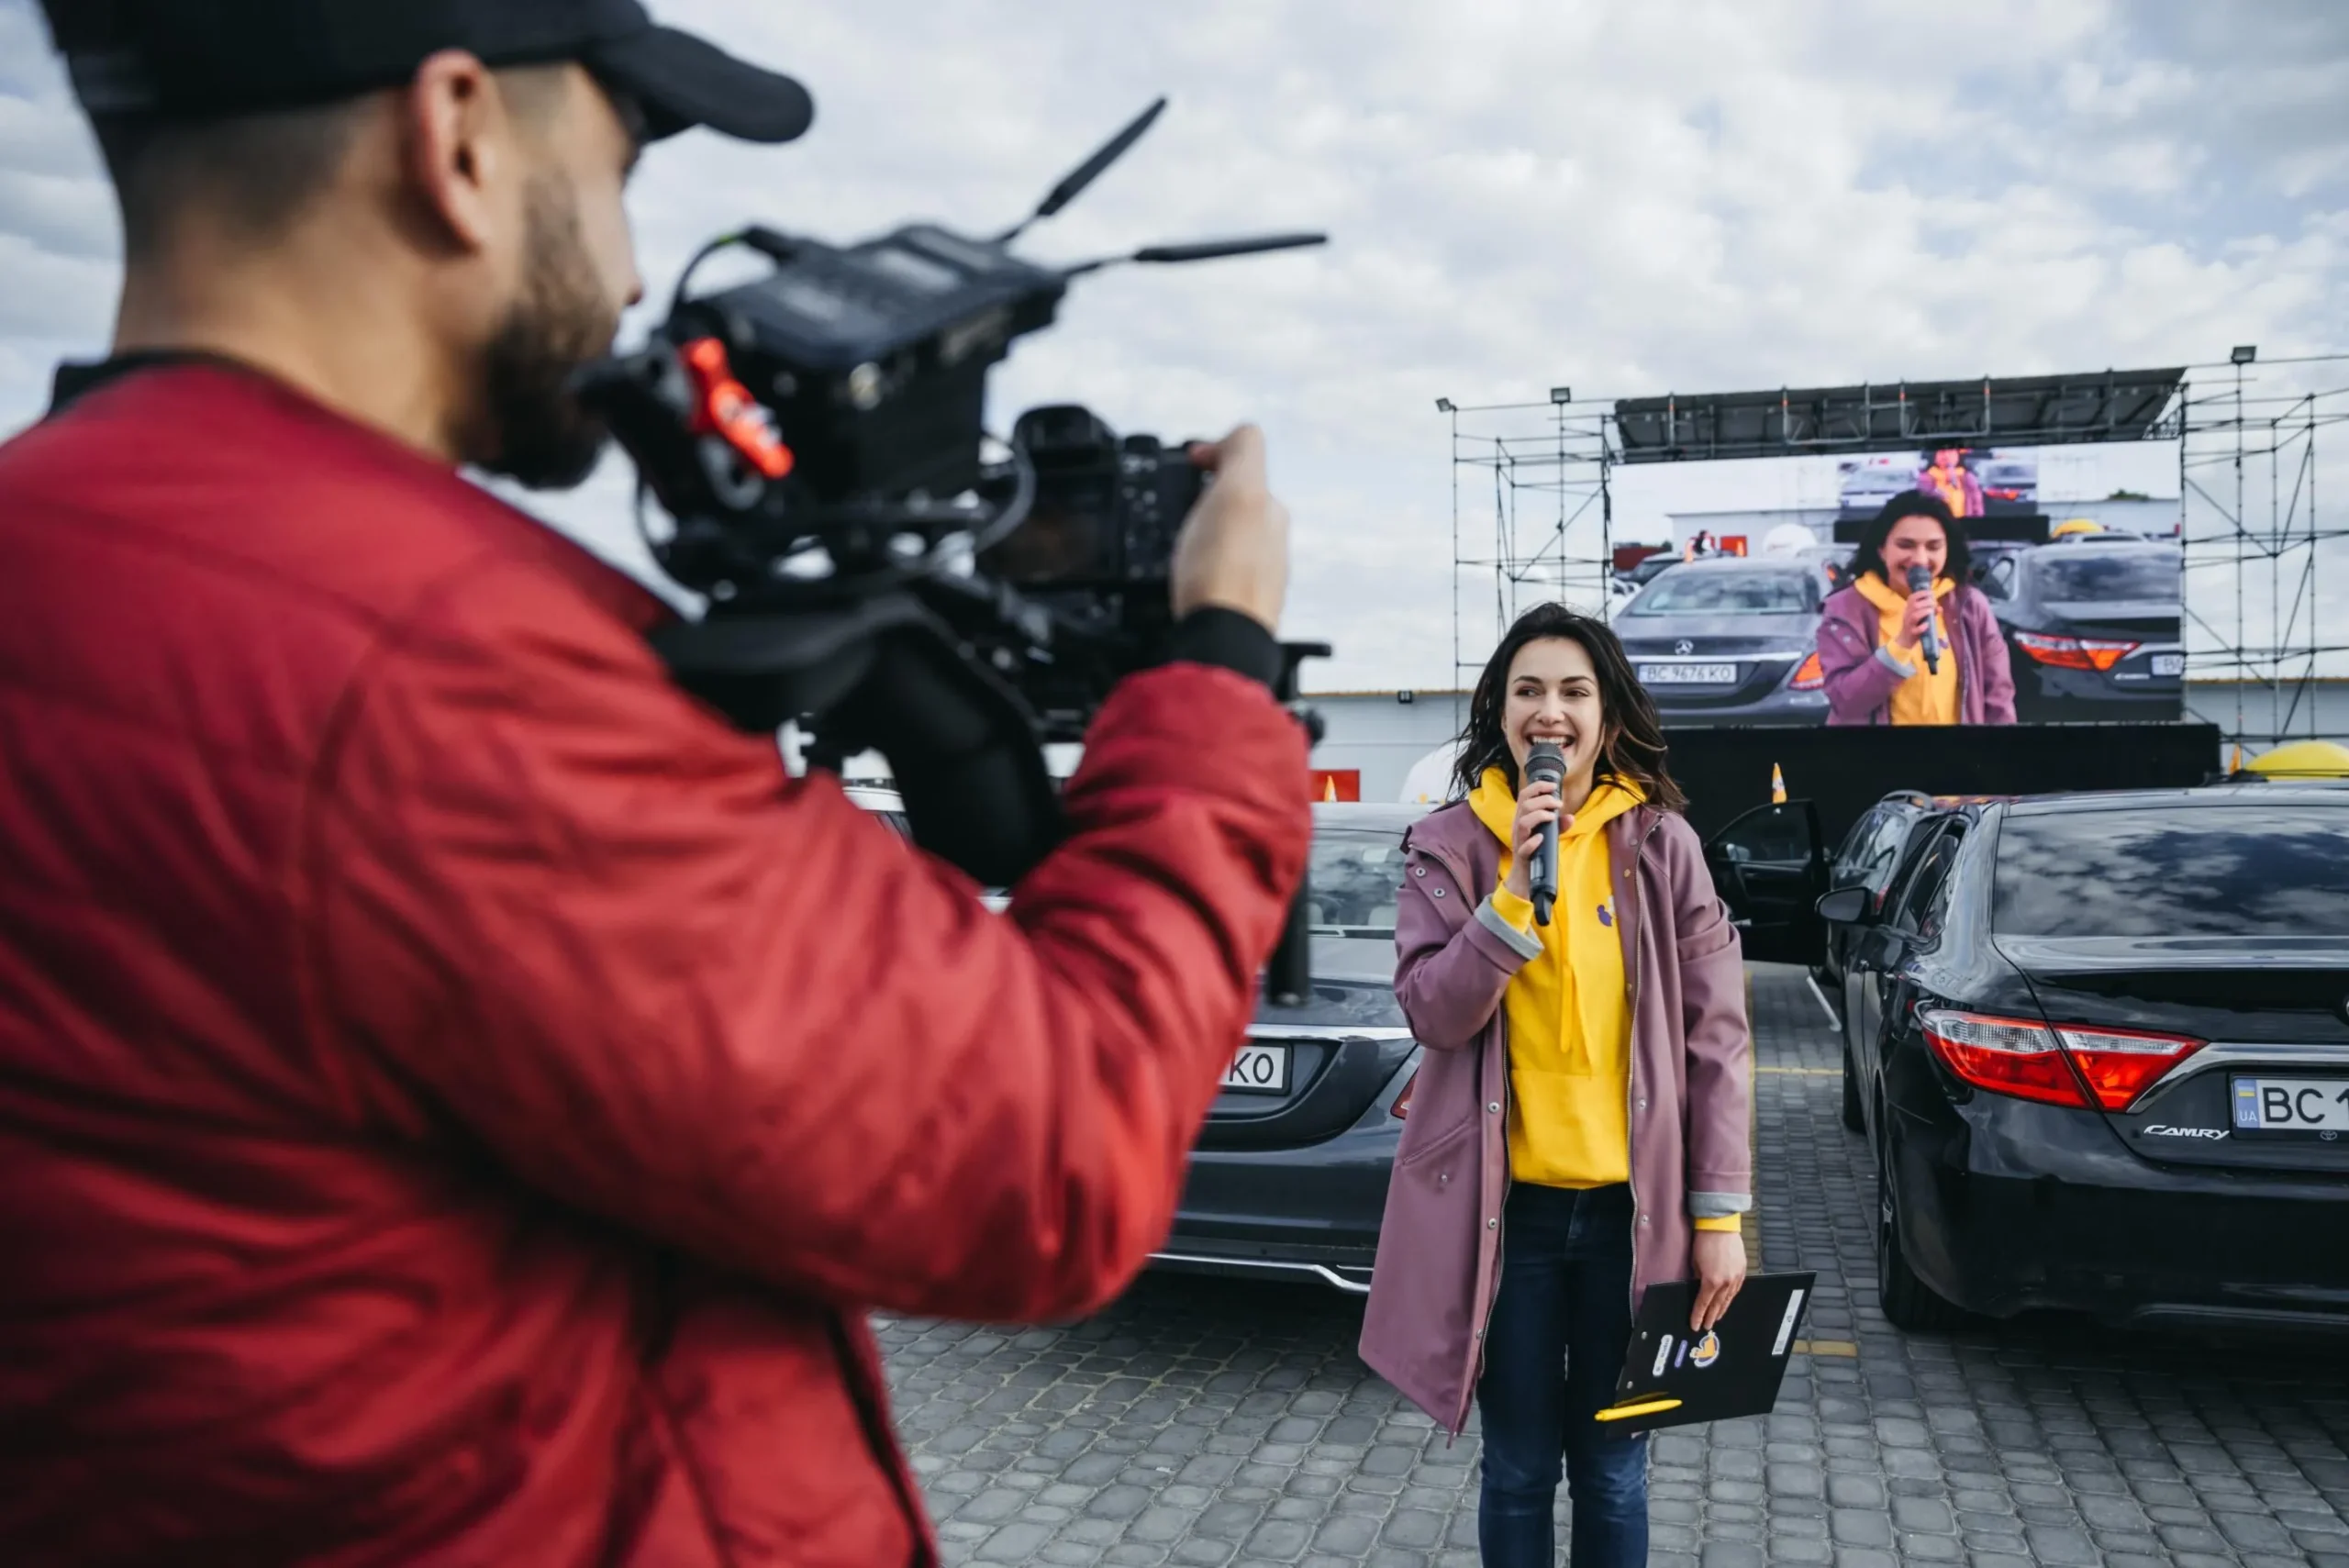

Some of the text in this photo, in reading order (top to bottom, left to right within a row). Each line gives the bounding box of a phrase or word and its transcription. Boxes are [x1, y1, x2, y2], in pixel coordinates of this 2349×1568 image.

[1229, 1051, 1274, 1084] KO
[2239, 1109, 2257, 1121] UA
[2262, 1087, 2325, 1124] BC
[2143, 1125, 2230, 1140] CAMRY
